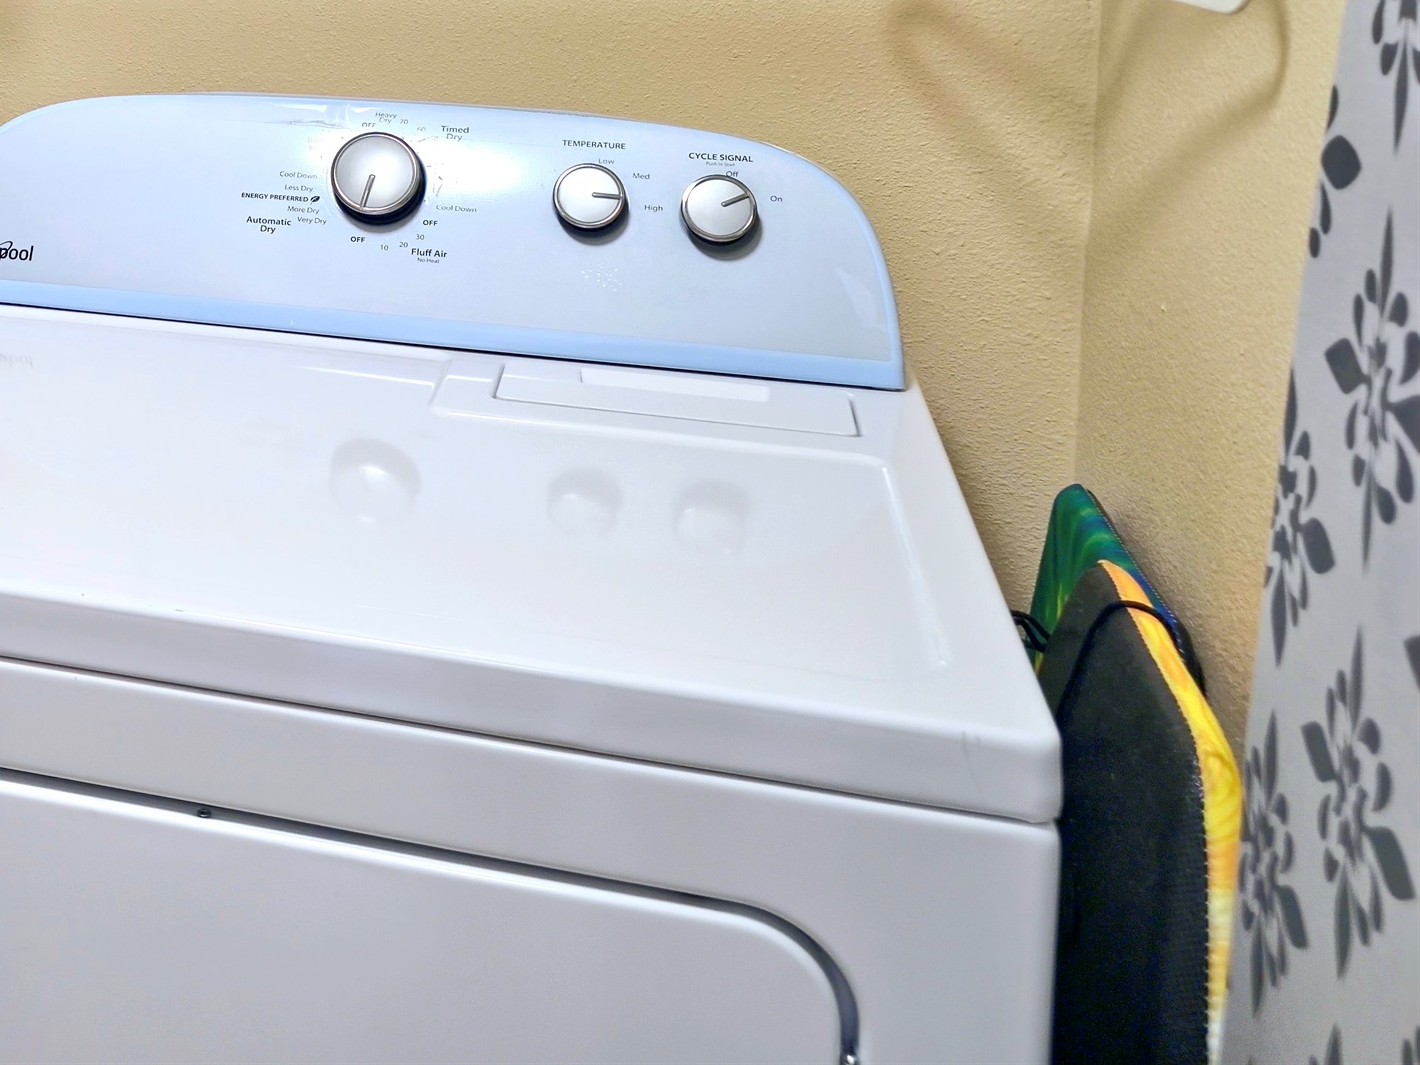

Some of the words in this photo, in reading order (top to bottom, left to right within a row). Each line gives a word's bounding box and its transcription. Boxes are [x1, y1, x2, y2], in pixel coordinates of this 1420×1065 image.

[441, 125, 470, 134] Timed
[446, 133, 463, 142] Dry
[562, 139, 626, 150] TEMPERATURE
[688, 152, 718, 162] CYCLE
[719, 154, 754, 163] SIGNAL
[297, 172, 318, 180] Down
[726, 170, 738, 178] Off
[300, 186, 314, 194] Dry
[241, 192, 268, 200] ENERGY
[270, 194, 309, 203] PREFERRED
[306, 206, 320, 215] Dry
[436, 204, 454, 212] Cool
[455, 205, 477, 214] Down
[644, 204, 664, 213] High
[246, 216, 292, 227] Automatic
[297, 216, 310, 226] Very
[312, 218, 327, 226] Dry
[260, 224, 276, 234] Dry
[411, 248, 430, 258] Fluff
[430, 250, 448, 258] Air
